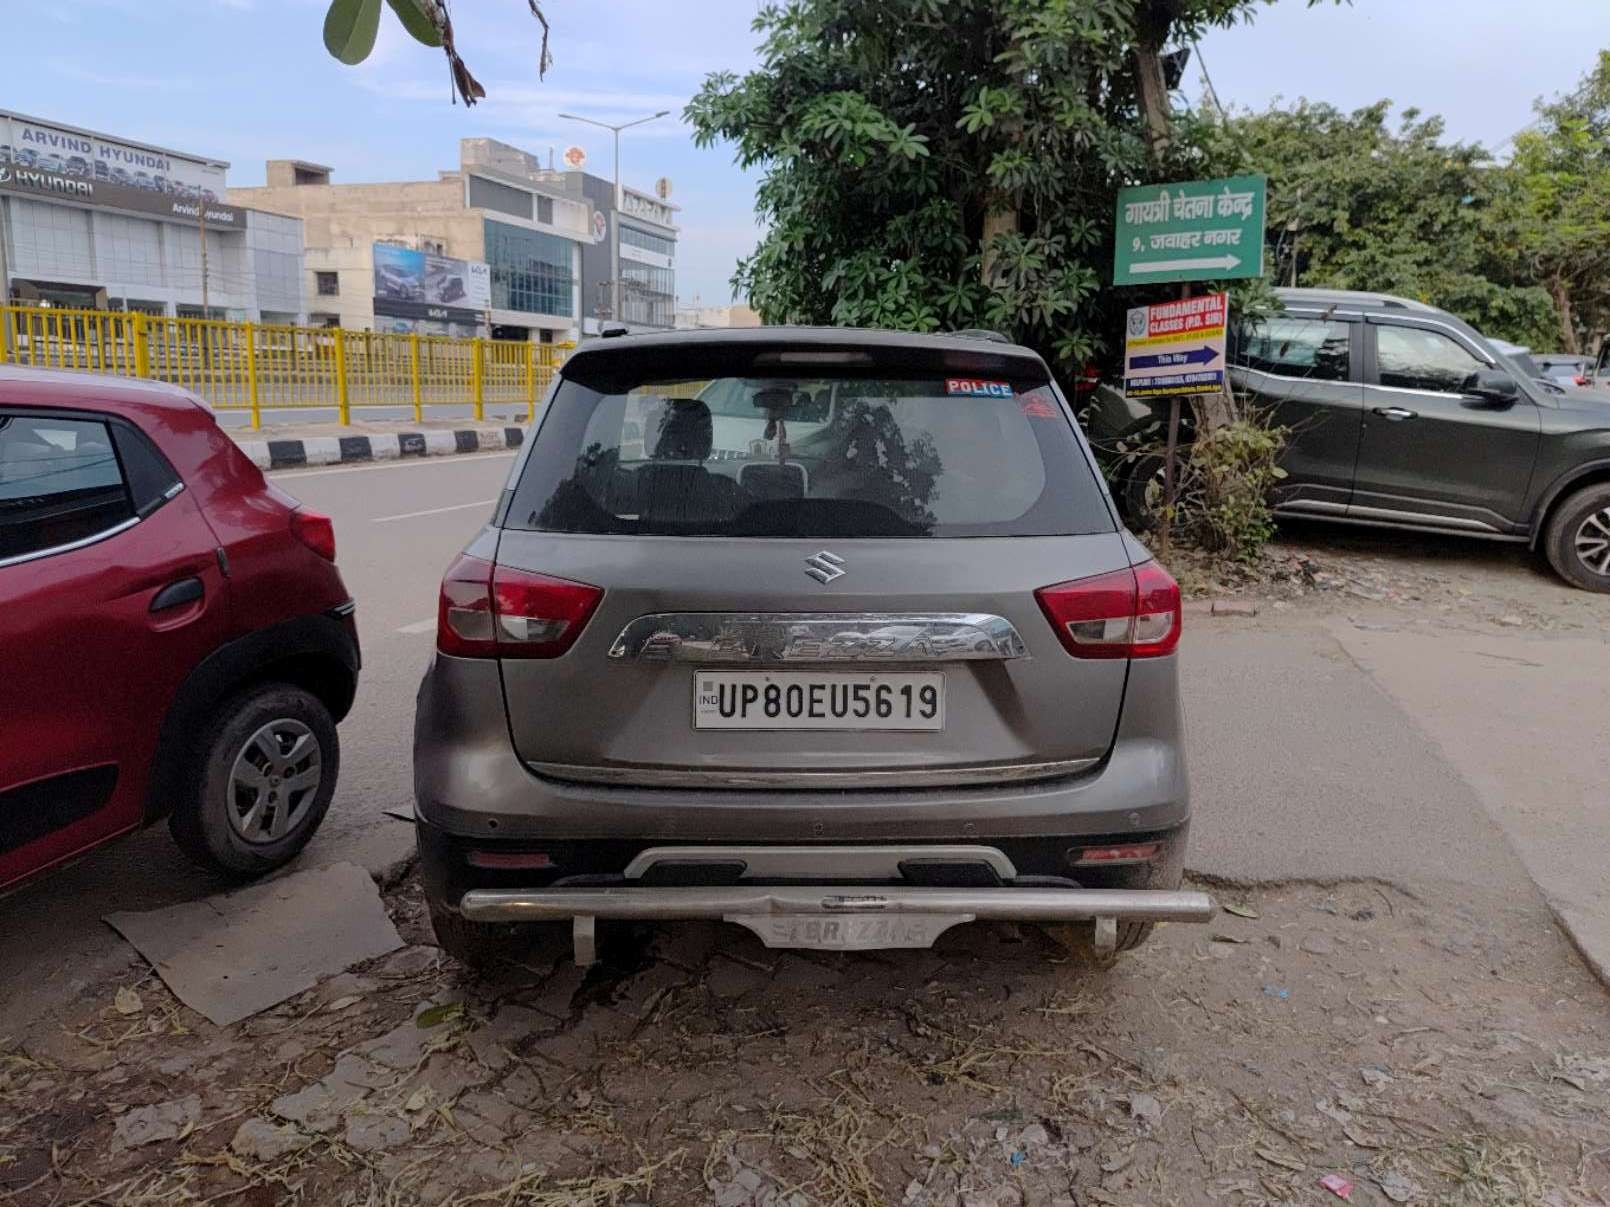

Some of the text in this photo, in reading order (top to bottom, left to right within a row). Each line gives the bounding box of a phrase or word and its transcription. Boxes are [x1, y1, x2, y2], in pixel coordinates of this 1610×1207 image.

[22, 128, 170, 171] ARVIND HYUNDAI
[15, 169, 93, 196] HYUNDAI
[1173, 189, 1214, 220] चेतना
[1217, 186, 1255, 221] केन्द्र
[1150, 231, 1202, 249] जवाहर
[1204, 228, 1242, 245] नगर
[1150, 296, 1223, 321] FUNDAMENTAL
[1150, 318, 1184, 333] CLASSES
[949, 380, 1011, 395] POLICE
[699, 683, 937, 718] IND UP80EU5619
